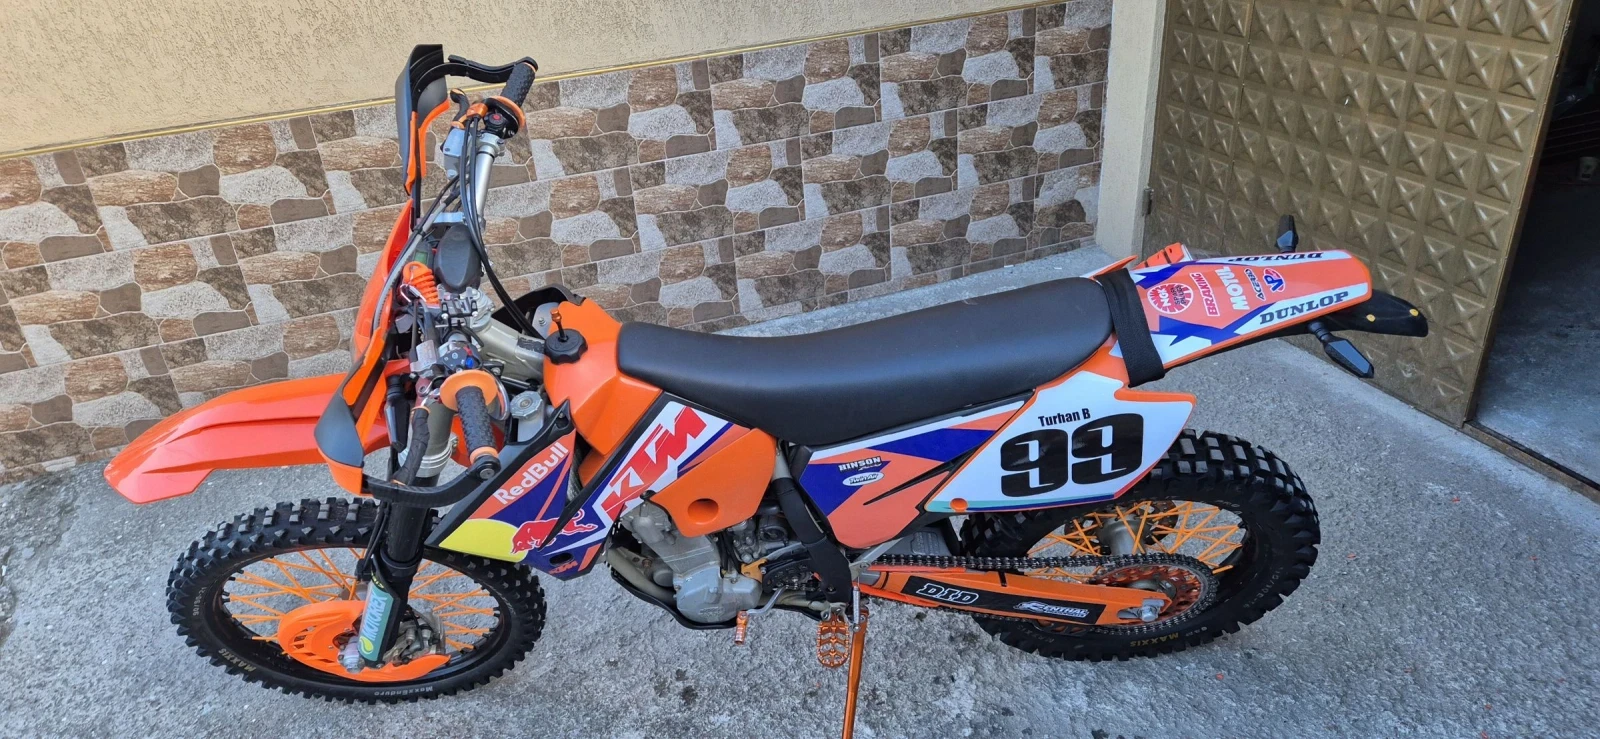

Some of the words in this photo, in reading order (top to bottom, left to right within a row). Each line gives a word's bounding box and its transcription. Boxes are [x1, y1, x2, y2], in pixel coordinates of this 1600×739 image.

[1228, 251, 1323, 263] DUNLOP
[1191, 273, 1219, 315] BRAKING
[1215, 266, 1250, 311] MOTUL
[1262, 267, 1286, 293] VP
[1155, 286, 1173, 313] NGK
[1259, 290, 1349, 325] DUNLOP
[1038, 411, 1081, 427] Turhan
[1082, 408, 1091, 419] B
[601, 406, 708, 522] KTM
[838, 457, 881, 471] HINSON
[1000, 412, 1144, 497] 99
[492, 441, 570, 506] RedBull
[361, 590, 388, 641] MOTOREX
[1130, 633, 1181, 649] MAXXIS
[218, 647, 257, 673] MAXXIS
